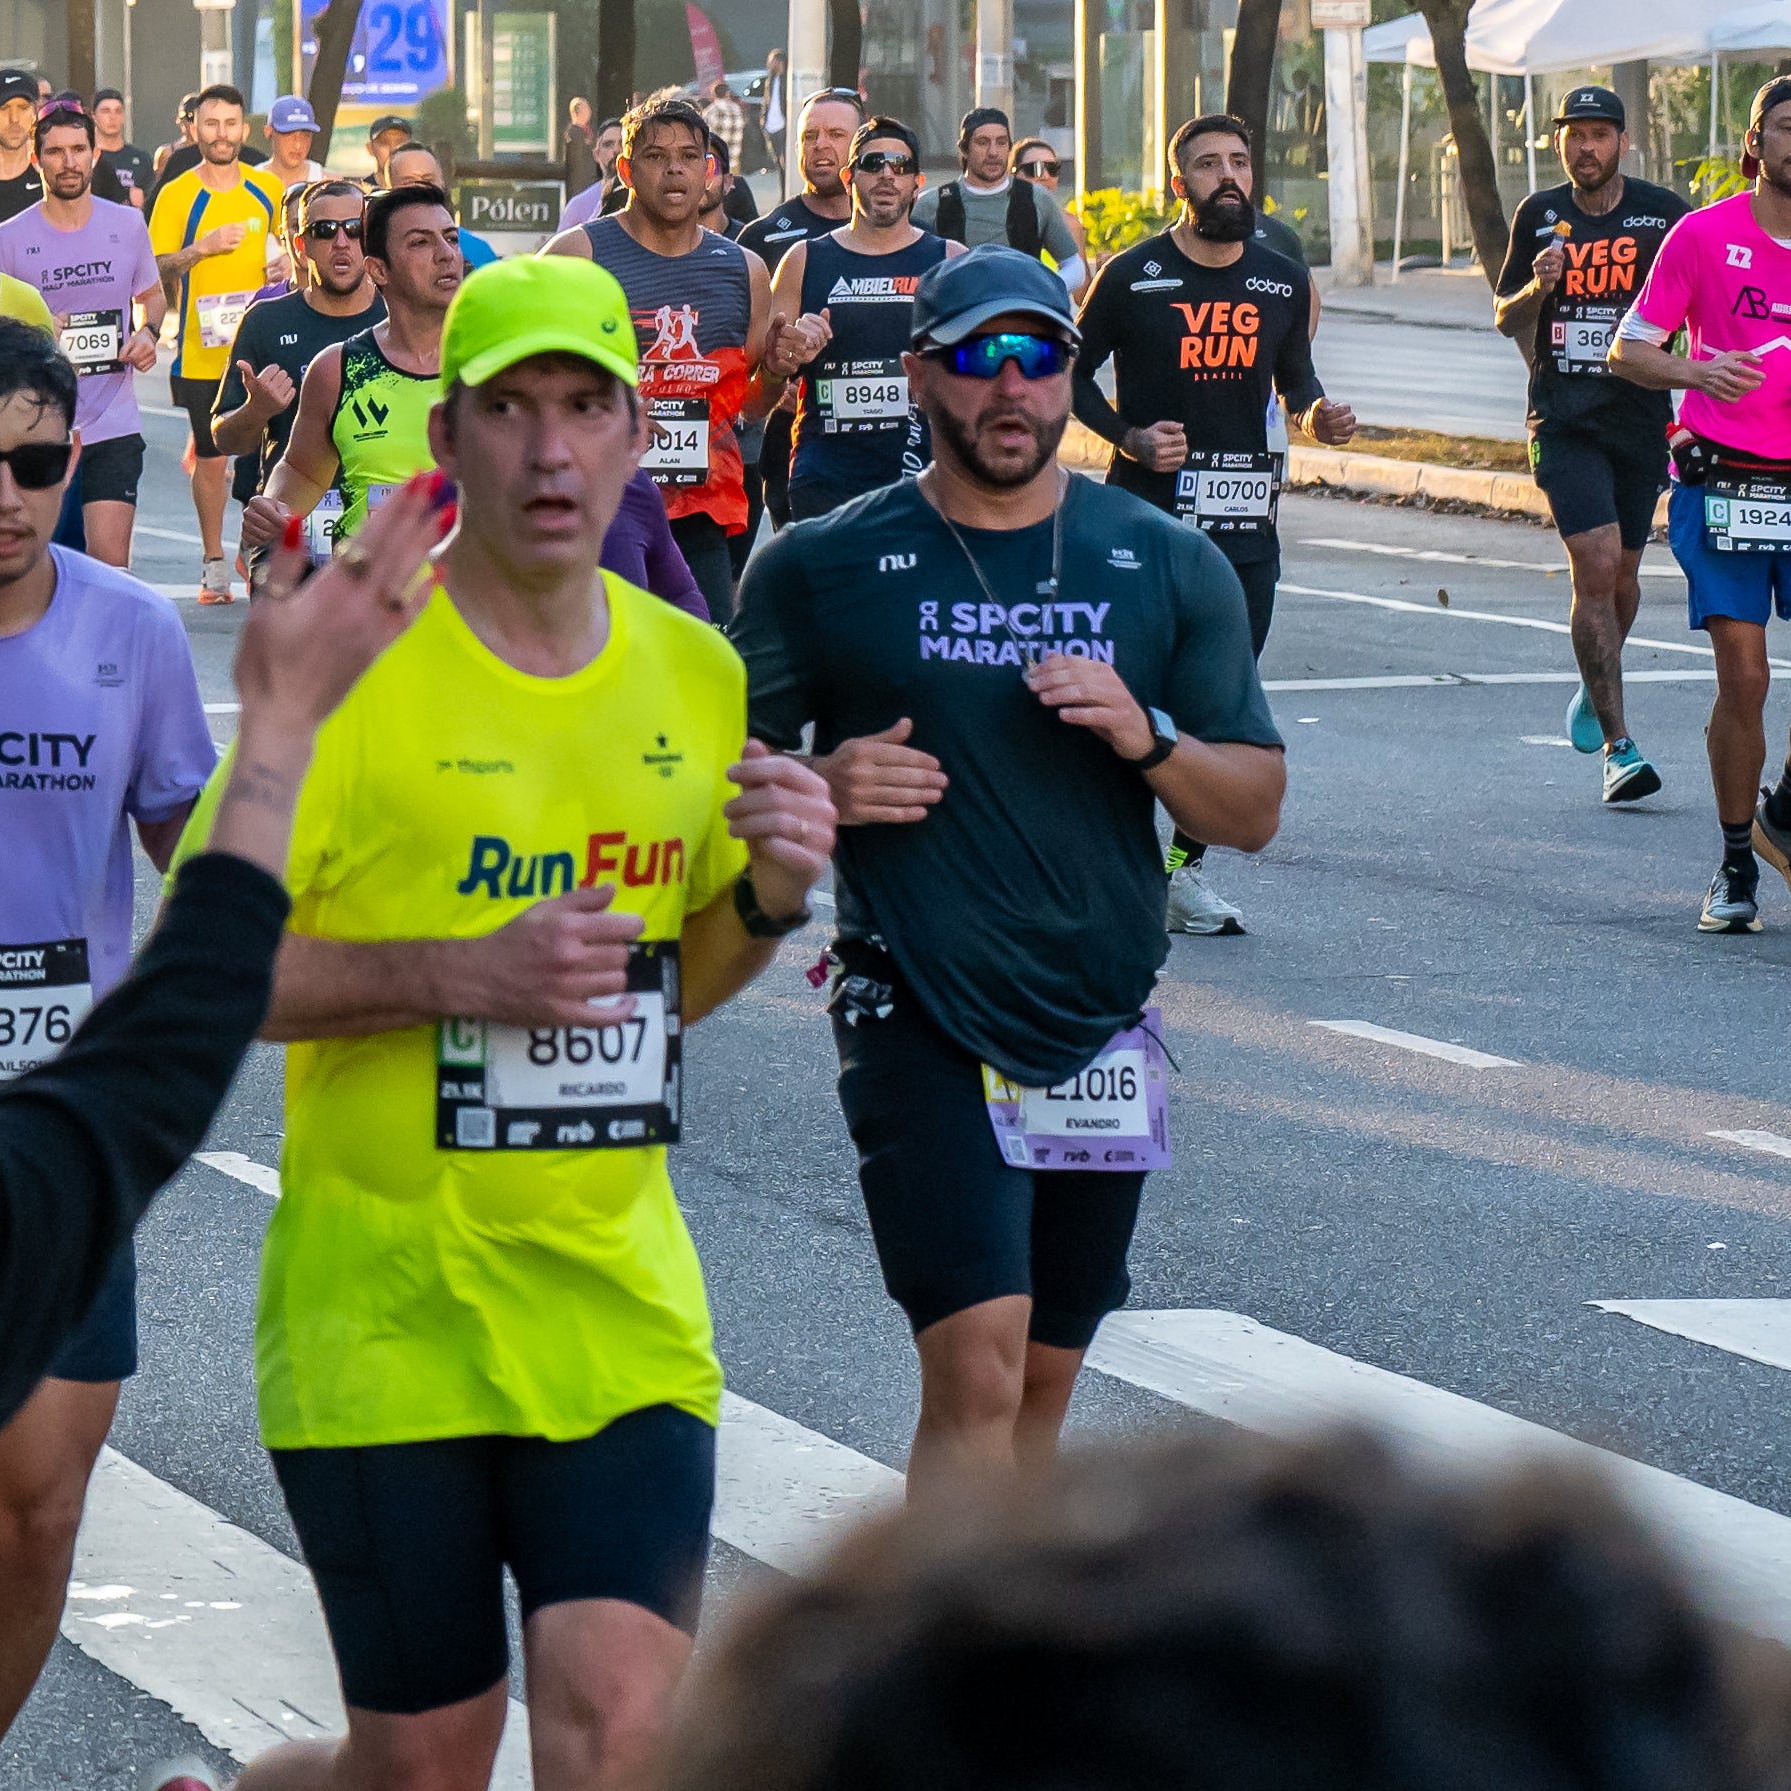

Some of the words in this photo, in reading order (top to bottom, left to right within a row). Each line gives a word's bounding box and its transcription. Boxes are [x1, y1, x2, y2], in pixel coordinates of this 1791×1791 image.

[370, 3, 439, 73] 29
[471, 194, 550, 222] Pólen
[1623, 215, 1666, 229] dobro
[1564, 236, 1637, 269] VEG
[53, 260, 112, 281] SPCITY
[1566, 264, 1636, 296] RUN
[67, 275, 115, 288] MARATHON
[1246, 276, 1293, 298] dobro
[1169, 301, 1260, 335] VEG
[66, 333, 110, 352] 7069
[280, 333, 298, 346] nu
[1179, 335, 1258, 369] RUN
[663, 363, 721, 383] CORRER
[851, 360, 883, 370] SPCITY
[820, 384, 829, 400] C
[845, 384, 900, 404] 8948
[654, 400, 685, 410] PCITY
[1223, 453, 1253, 462] SPCITY
[1182, 475, 1194, 492] D
[1206, 479, 1267, 500] 10700
[1750, 484, 1787, 495] SPCITY
[1713, 502, 1725, 520] C
[878, 553, 917, 572] nu
[950, 601, 1112, 635] SPCITY
[919, 635, 1115, 666] MARATHON
[528, 1016, 647, 1066] 8607
[559, 1081, 628, 1096] RICARDO
[1065, 1117, 1121, 1130] EVANDRO
